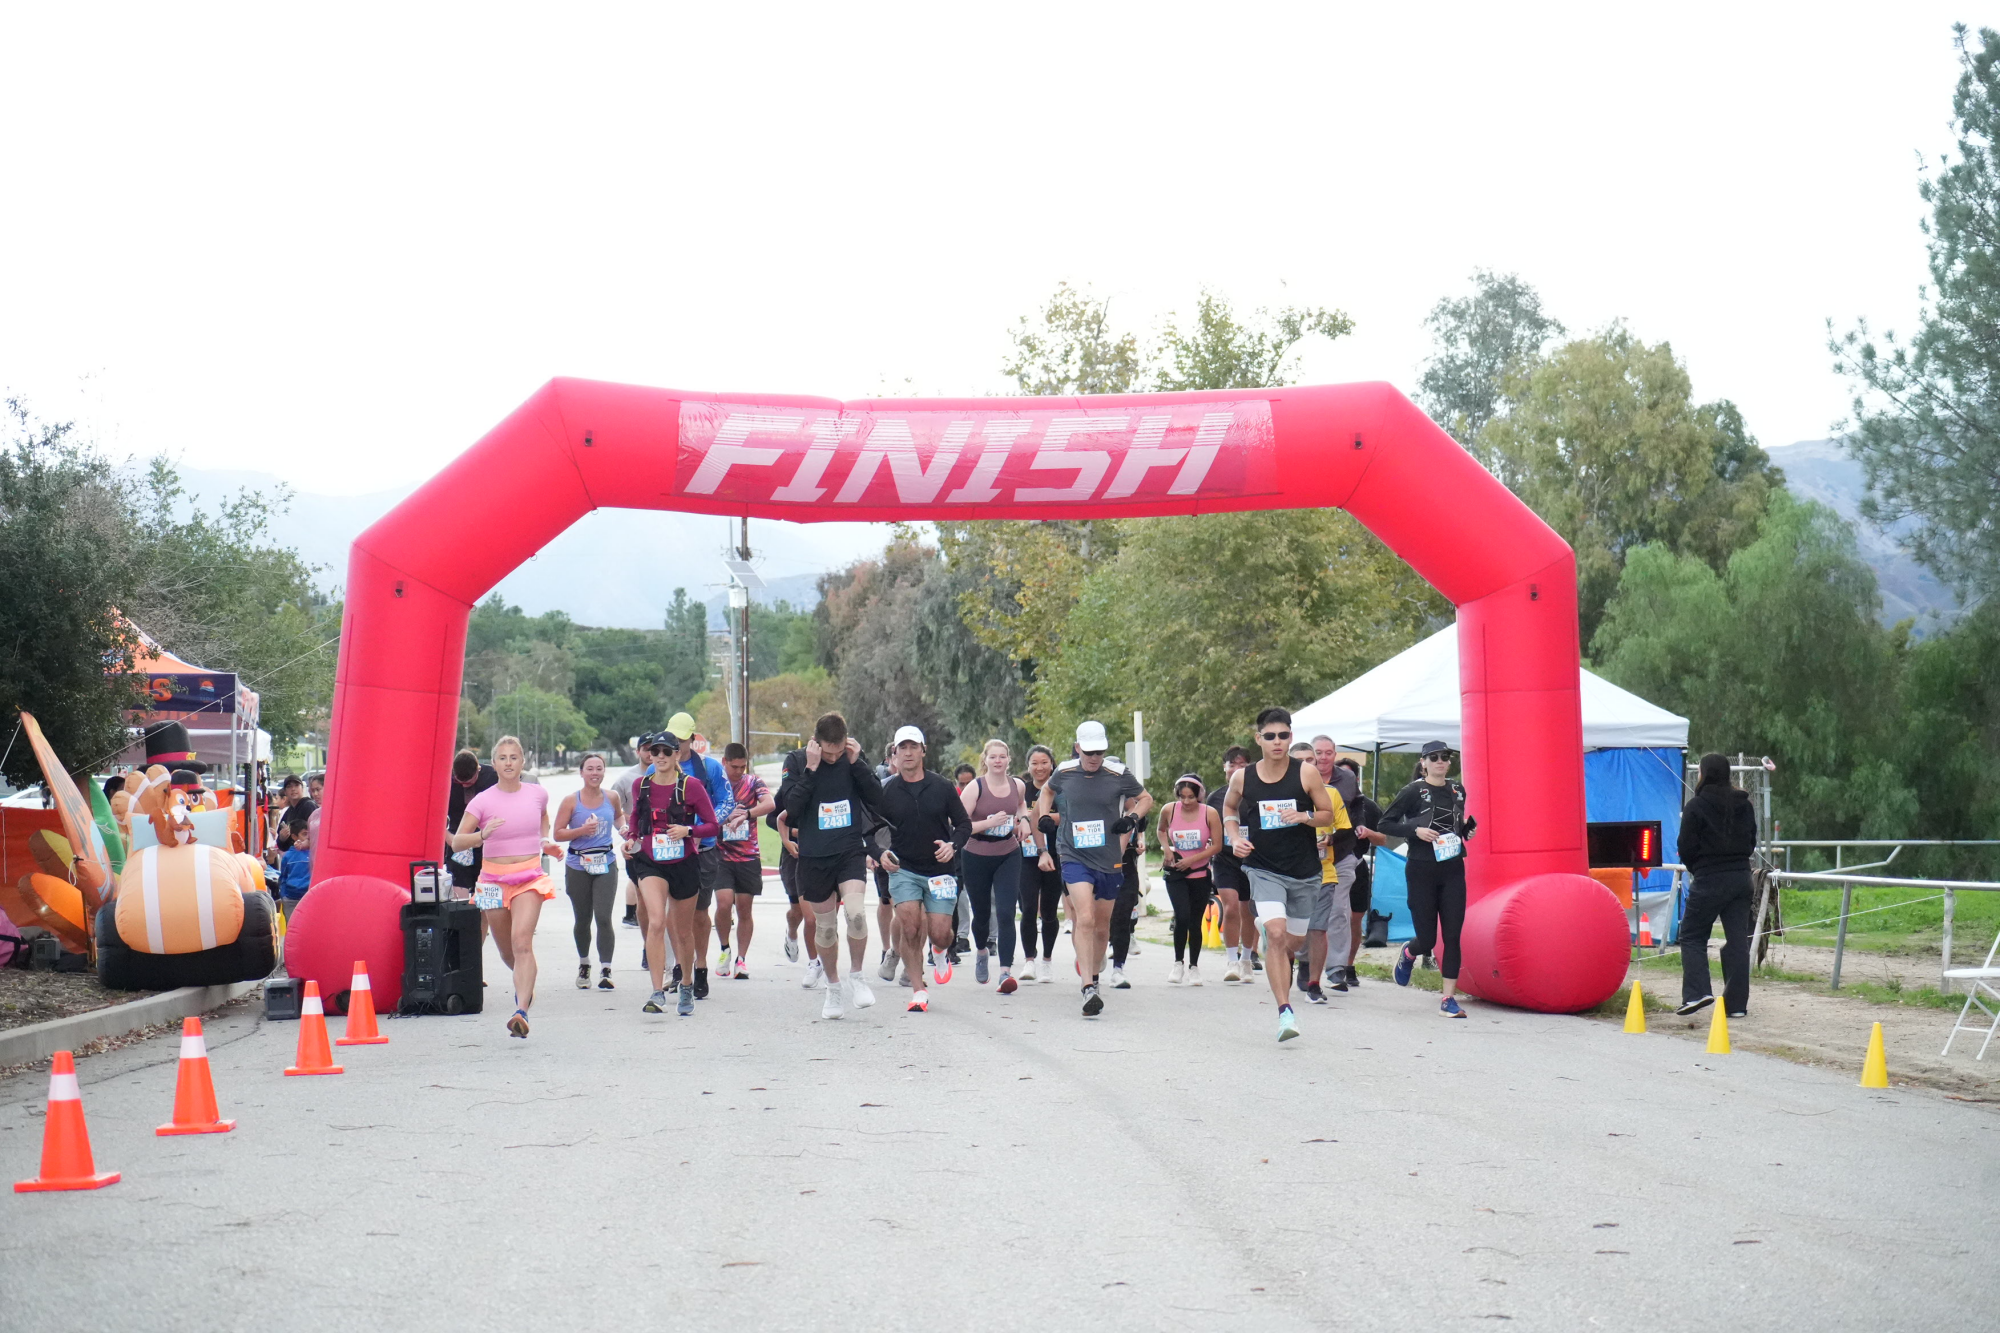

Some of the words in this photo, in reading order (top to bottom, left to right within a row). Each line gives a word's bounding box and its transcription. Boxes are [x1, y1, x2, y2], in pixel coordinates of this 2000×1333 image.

[683, 412, 1234, 503] FINISH
[690, 740, 705, 750] OP
[824, 815, 848, 828] 2431
[726, 831, 746, 840] 2464
[988, 826, 1010, 836] 2446
[1077, 835, 1102, 847] 2455
[1178, 840, 1198, 850] 2454
[656, 847, 681, 860] 2442
[1439, 844, 1460, 859] 2462
[935, 887, 956, 900] 2432
